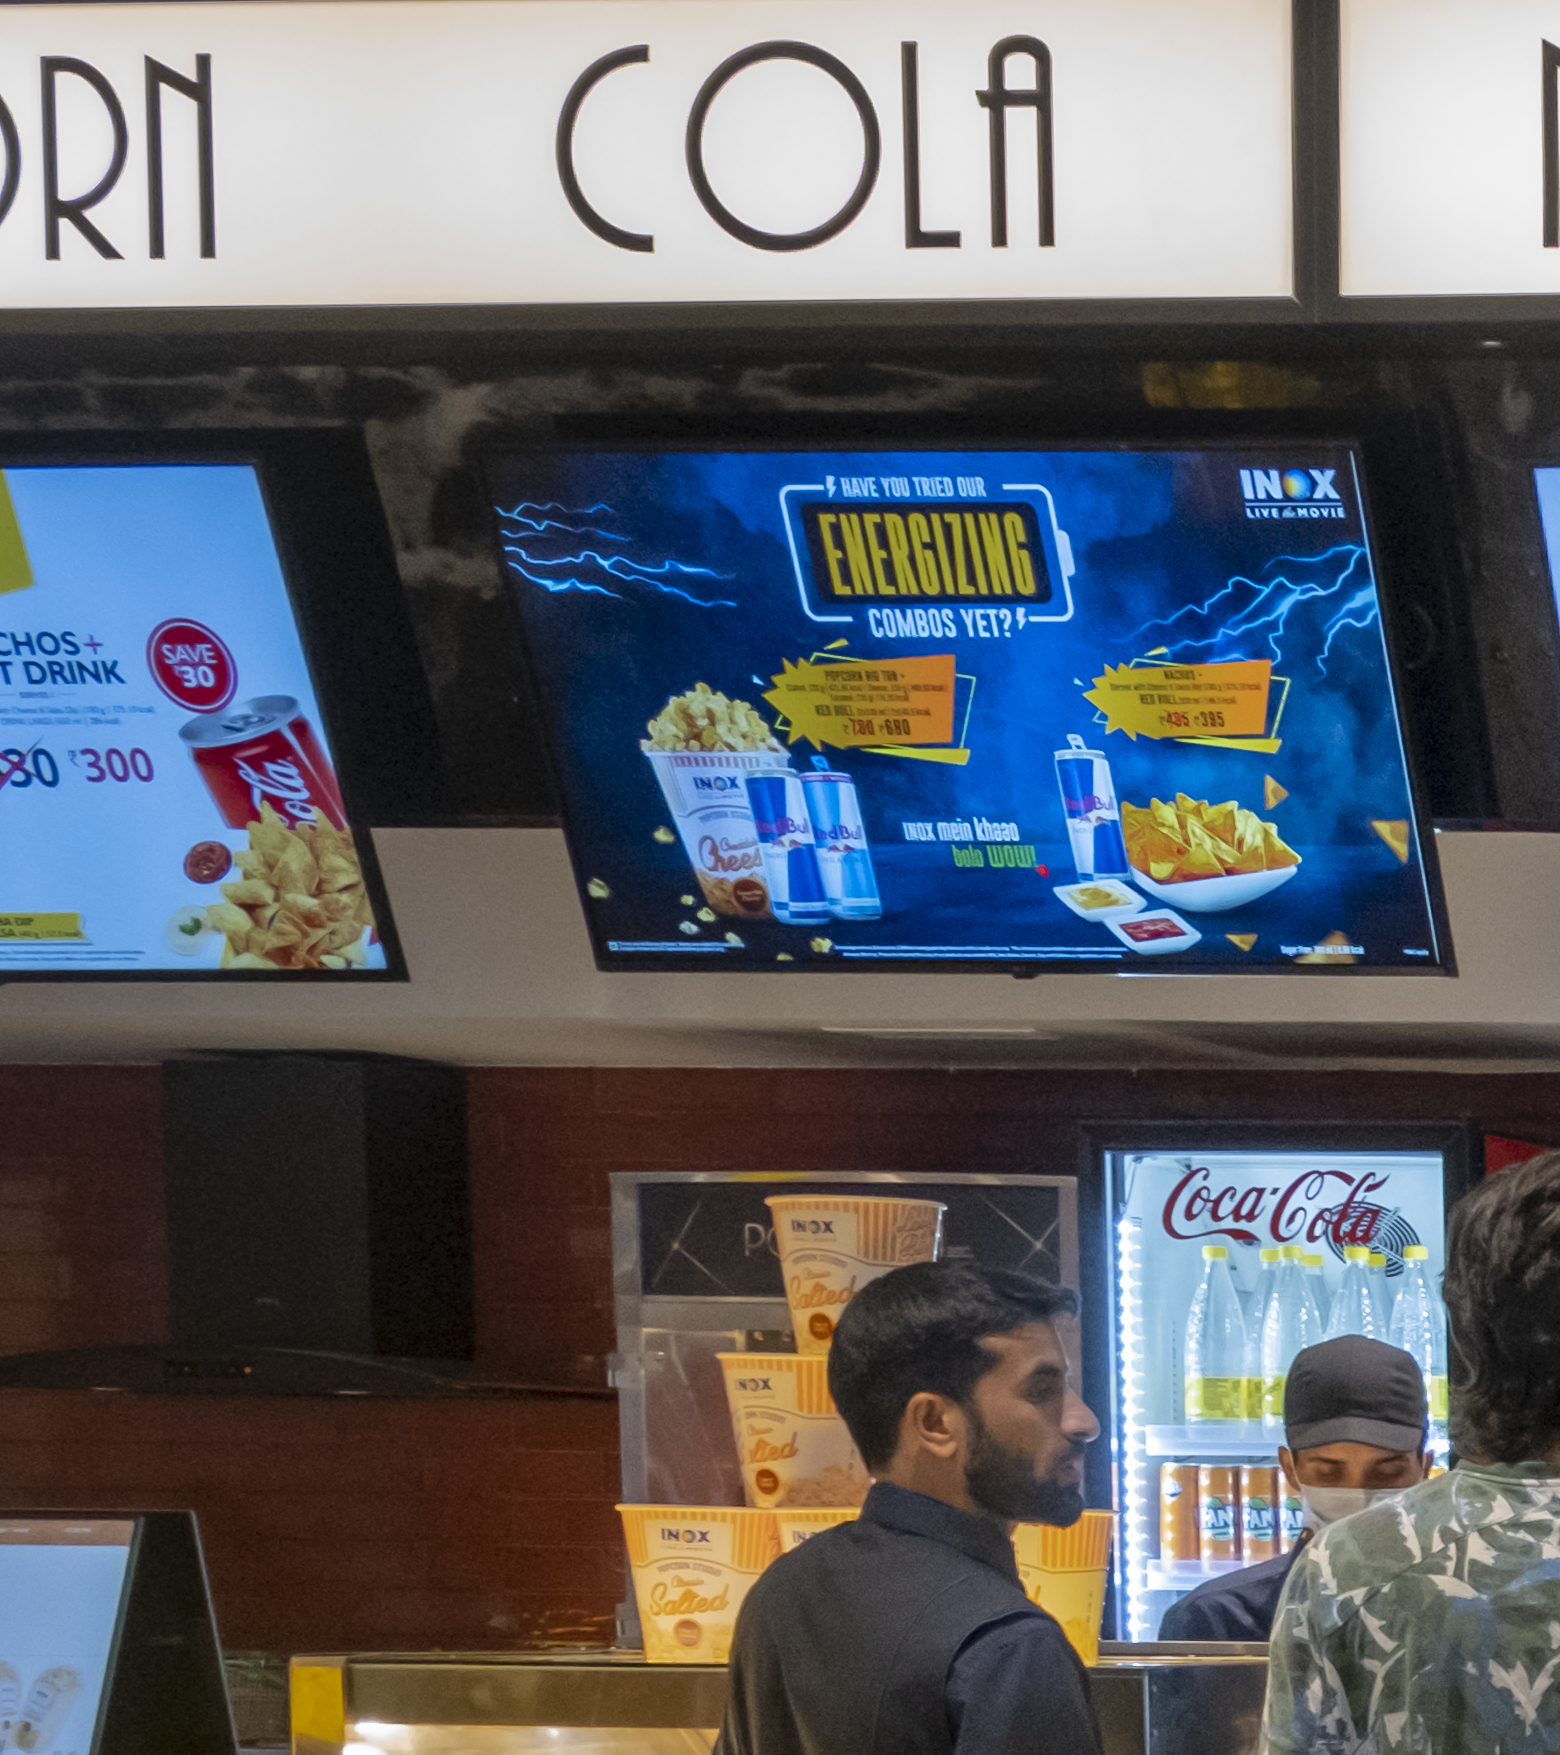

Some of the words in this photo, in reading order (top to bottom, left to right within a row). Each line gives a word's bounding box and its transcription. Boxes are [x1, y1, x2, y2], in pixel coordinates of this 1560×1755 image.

[0, 53, 216, 259] RN
[556, 35, 1055, 252] COLA
[840, 476, 877, 497] HAVE
[881, 476, 910, 497] YOU
[912, 476, 955, 497] TRIED
[957, 476, 987, 497] OUR
[1240, 468, 1341, 500] INOX
[1245, 507, 1280, 518] LIVE
[1296, 507, 1346, 519] MOVIE
[817, 511, 1037, 596] ENERGIZING
[867, 607, 958, 638] COMBOS
[963, 608, 1012, 637] YET?
[161, 644, 218, 664] SAVE
[23, 660, 127, 685] DRINK
[1162, 1165, 1392, 1246] Coca-Cola
[791, 1219, 835, 1235] INOX
[661, 1528, 711, 1544] INOX
[650, 1581, 730, 1616] Salted
